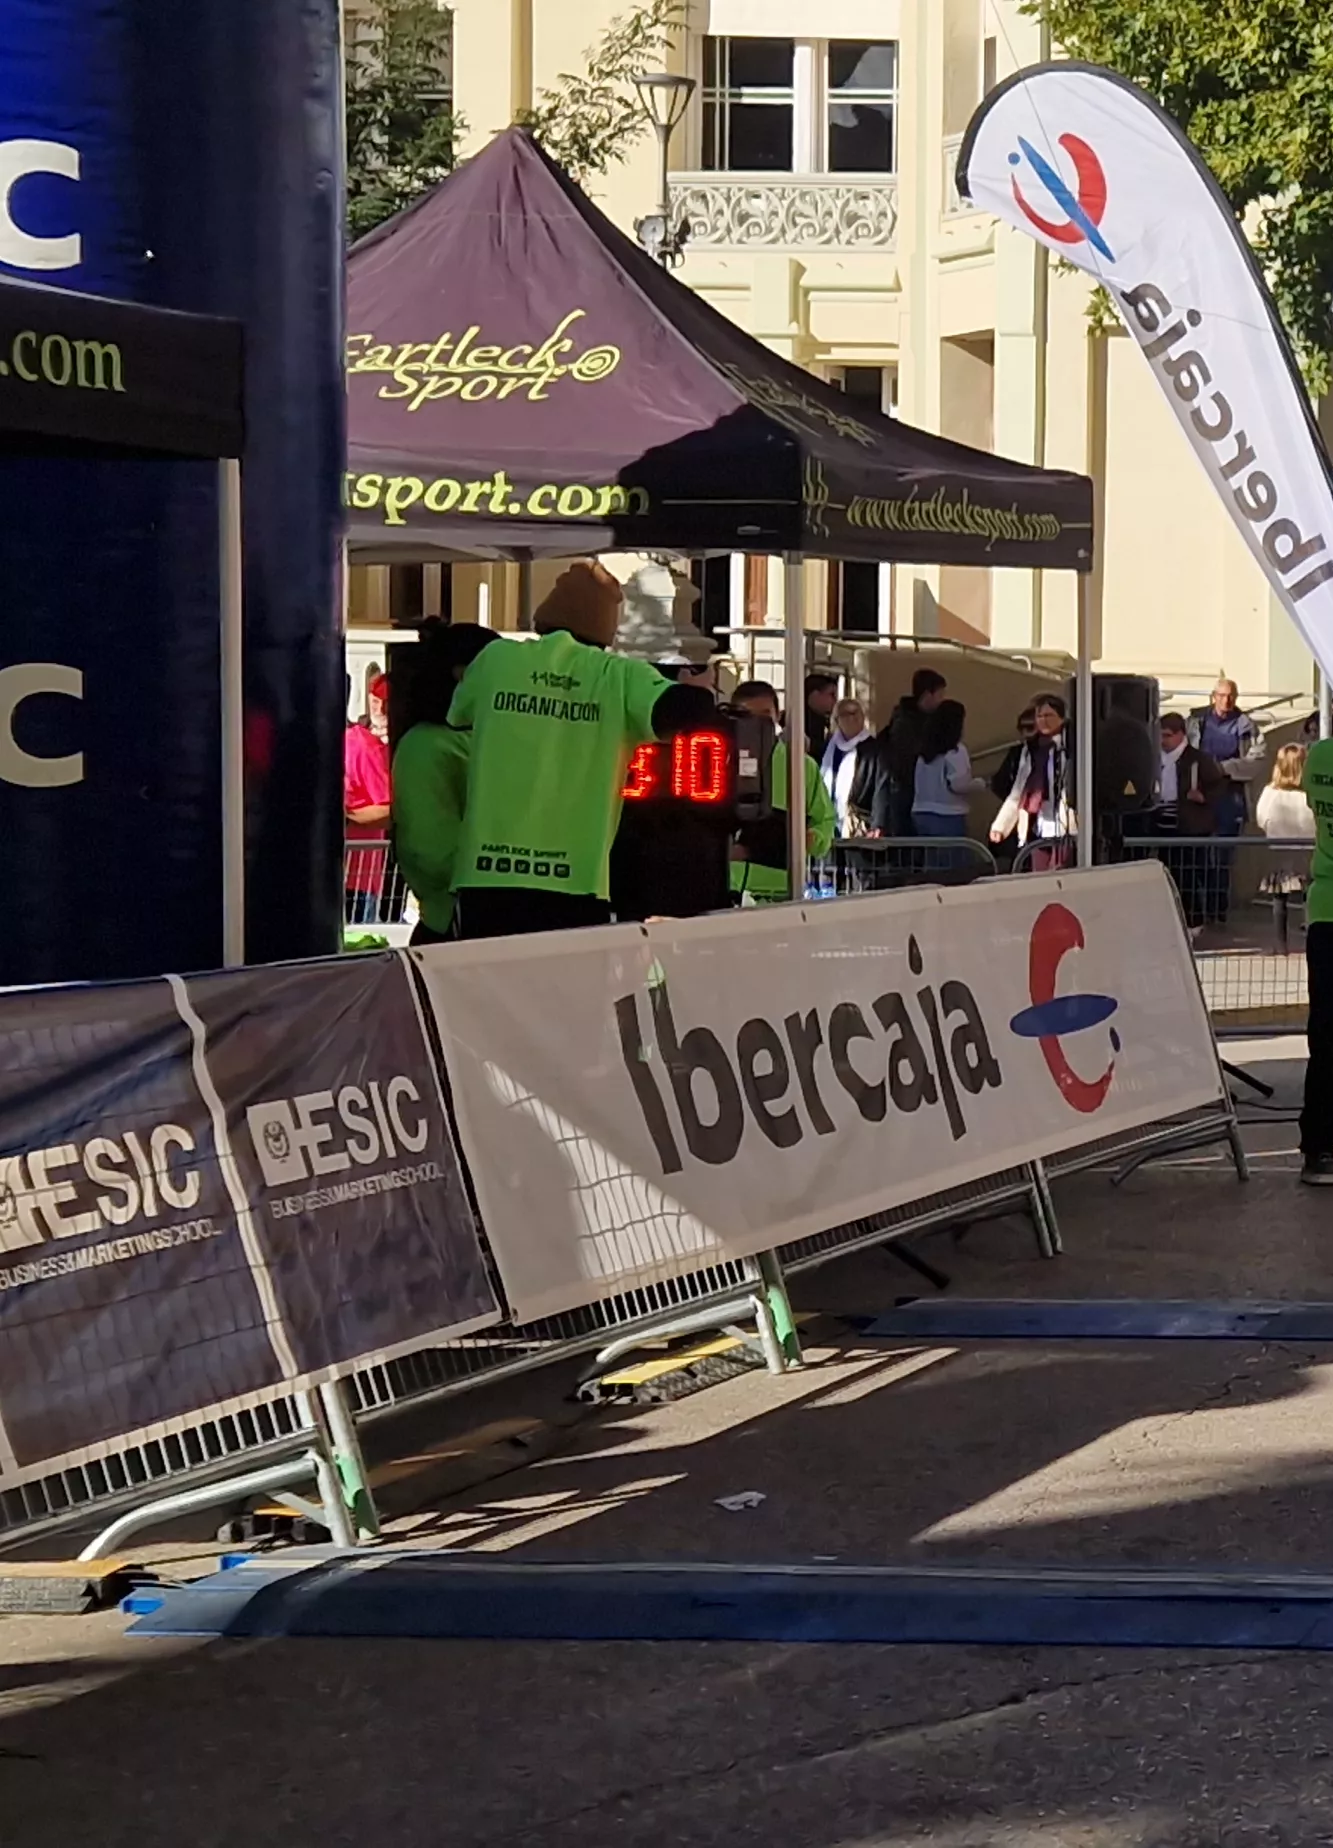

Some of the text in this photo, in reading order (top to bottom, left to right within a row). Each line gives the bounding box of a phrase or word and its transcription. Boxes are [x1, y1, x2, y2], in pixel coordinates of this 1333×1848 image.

[378, 362, 558, 412] Sport
[614, 932, 1003, 1175] Ibercaja
[294, 1075, 429, 1177] ESIC
[27, 1123, 201, 1241] ESIC
